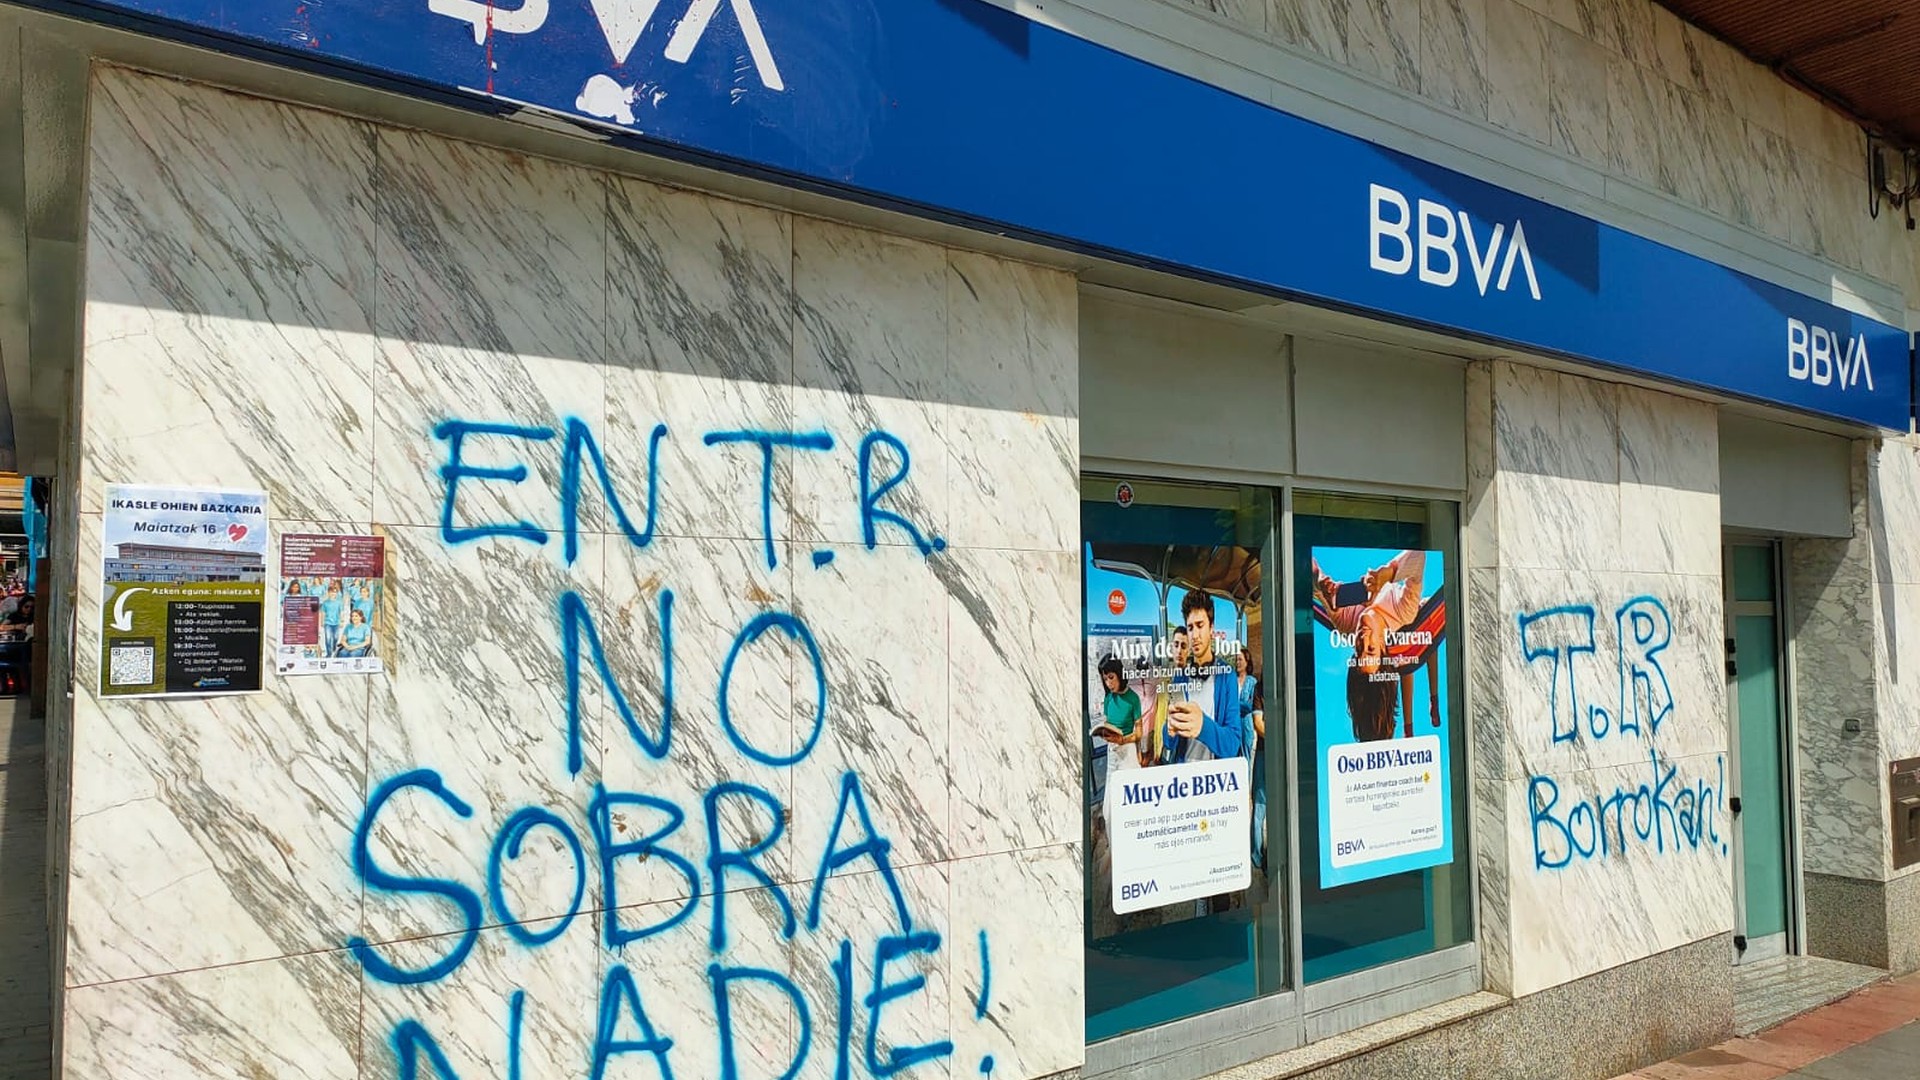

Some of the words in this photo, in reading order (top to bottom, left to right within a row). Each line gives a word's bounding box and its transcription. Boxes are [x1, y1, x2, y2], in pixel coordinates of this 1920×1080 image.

[1369, 183, 1541, 300] BBVA
[1787, 317, 1873, 391] BBVA
[434, 415, 668, 567] EN
[112, 499, 158, 510] IKASLE
[160, 501, 198, 512] OHIEN
[200, 502, 262, 514] BAZKARIA
[133, 521, 198, 534] Maiatzak
[202, 524, 216, 534] 16
[151, 587, 180, 596] Azken
[181, 588, 212, 598] eguna:
[214, 588, 252, 596] maiatzak
[1330, 629, 1356, 648] Oso
[1110, 638, 1152, 664] Muy
[1122, 667, 1150, 680] hacer
[1152, 666, 1183, 678] bizum
[1184, 665, 1196, 676] de
[1198, 662, 1232, 676] camino
[560, 589, 828, 779] NO
[1156, 682, 1164, 693] al
[1167, 680, 1202, 694] cumple
[1337, 755, 1364, 774] Oso
[1367, 749, 1433, 770] BBVArena
[1121, 783, 1164, 807] Muy
[1167, 776, 1189, 800] de
[1192, 771, 1239, 797] BBVA
[1143, 817, 1156, 826] una
[1185, 808, 1207, 819] oculta
[1207, 807, 1220, 816] sus
[1221, 804, 1239, 814] datos
[1337, 838, 1365, 856] BBVA
[347, 768, 915, 985] SOBRA
[1121, 879, 1159, 901] BBVA
